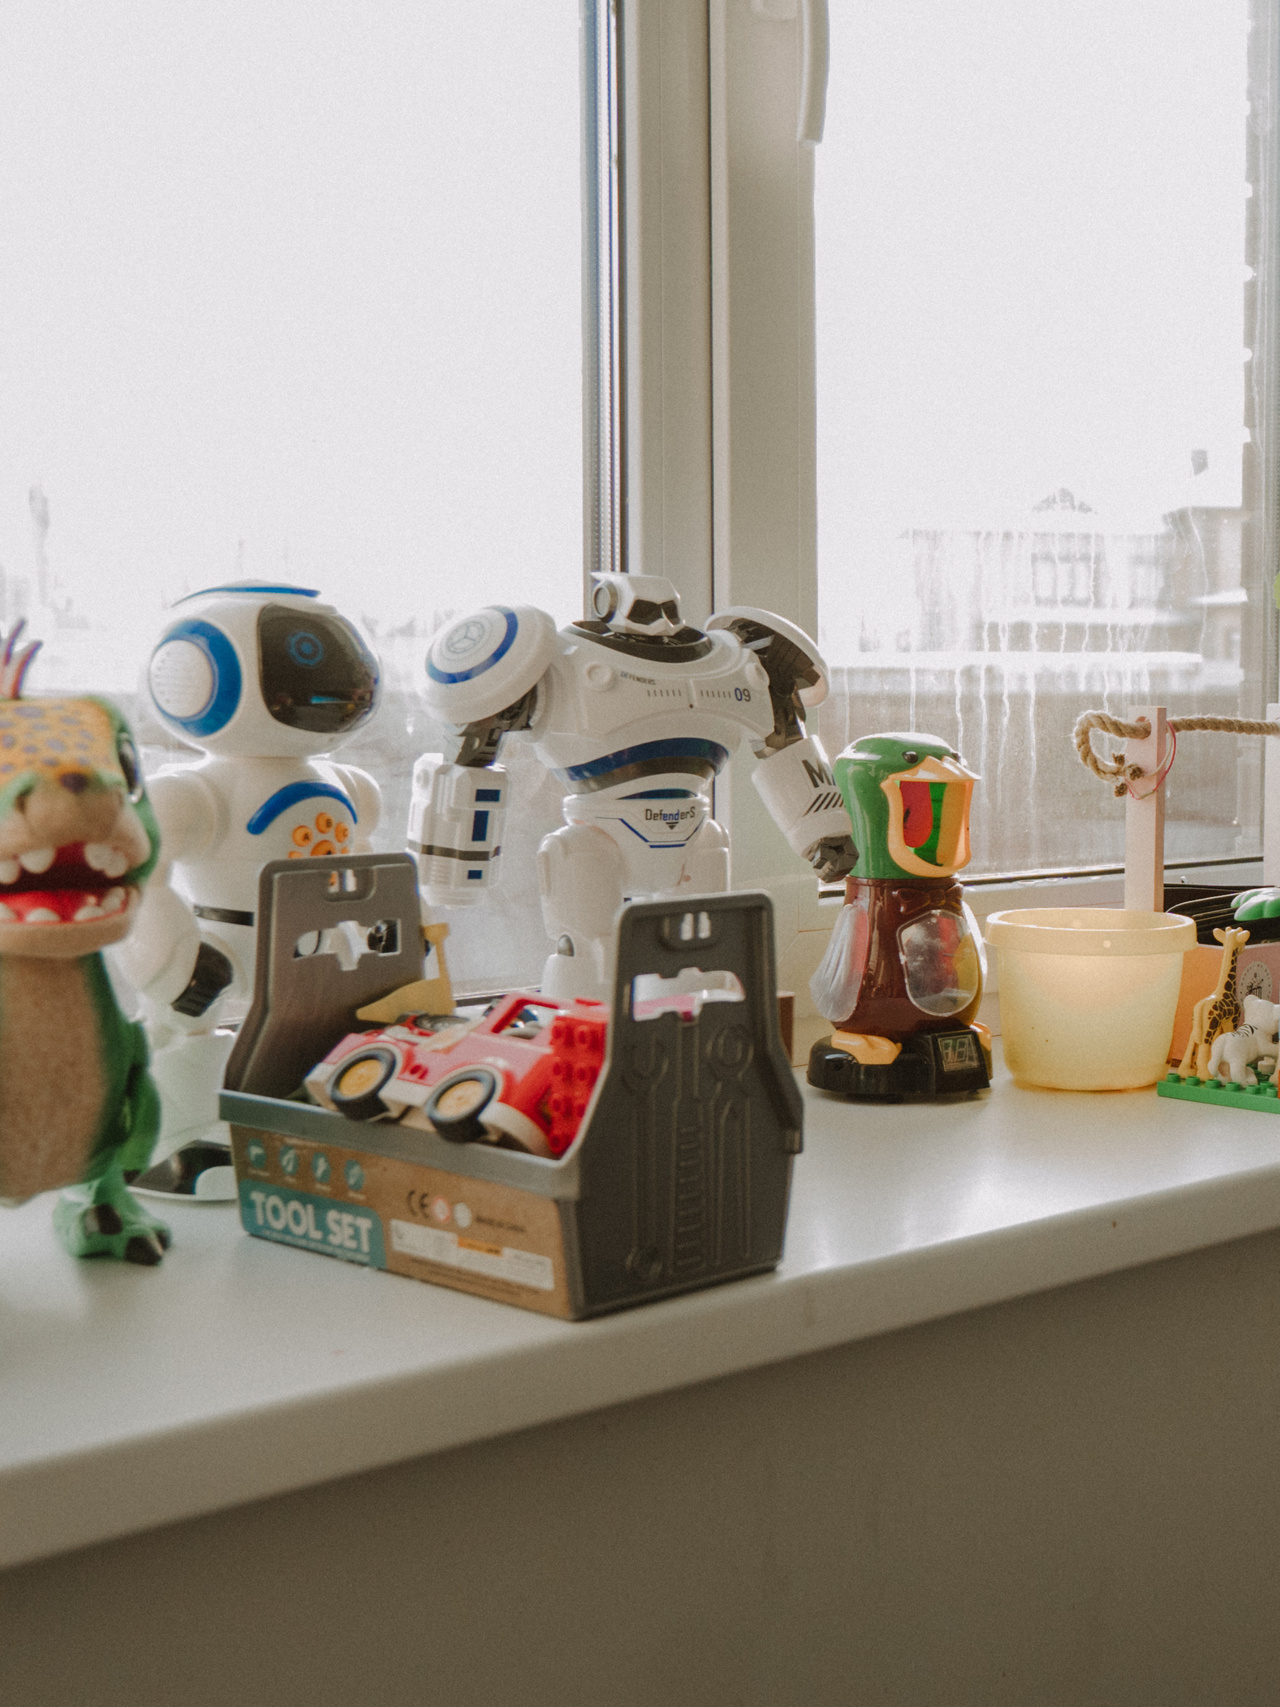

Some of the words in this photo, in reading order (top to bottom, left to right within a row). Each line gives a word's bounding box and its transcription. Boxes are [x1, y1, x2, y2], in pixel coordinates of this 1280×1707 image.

[734, 687, 752, 702] 09
[249, 1191, 324, 1241] TOOL
[326, 1209, 373, 1253] SET
